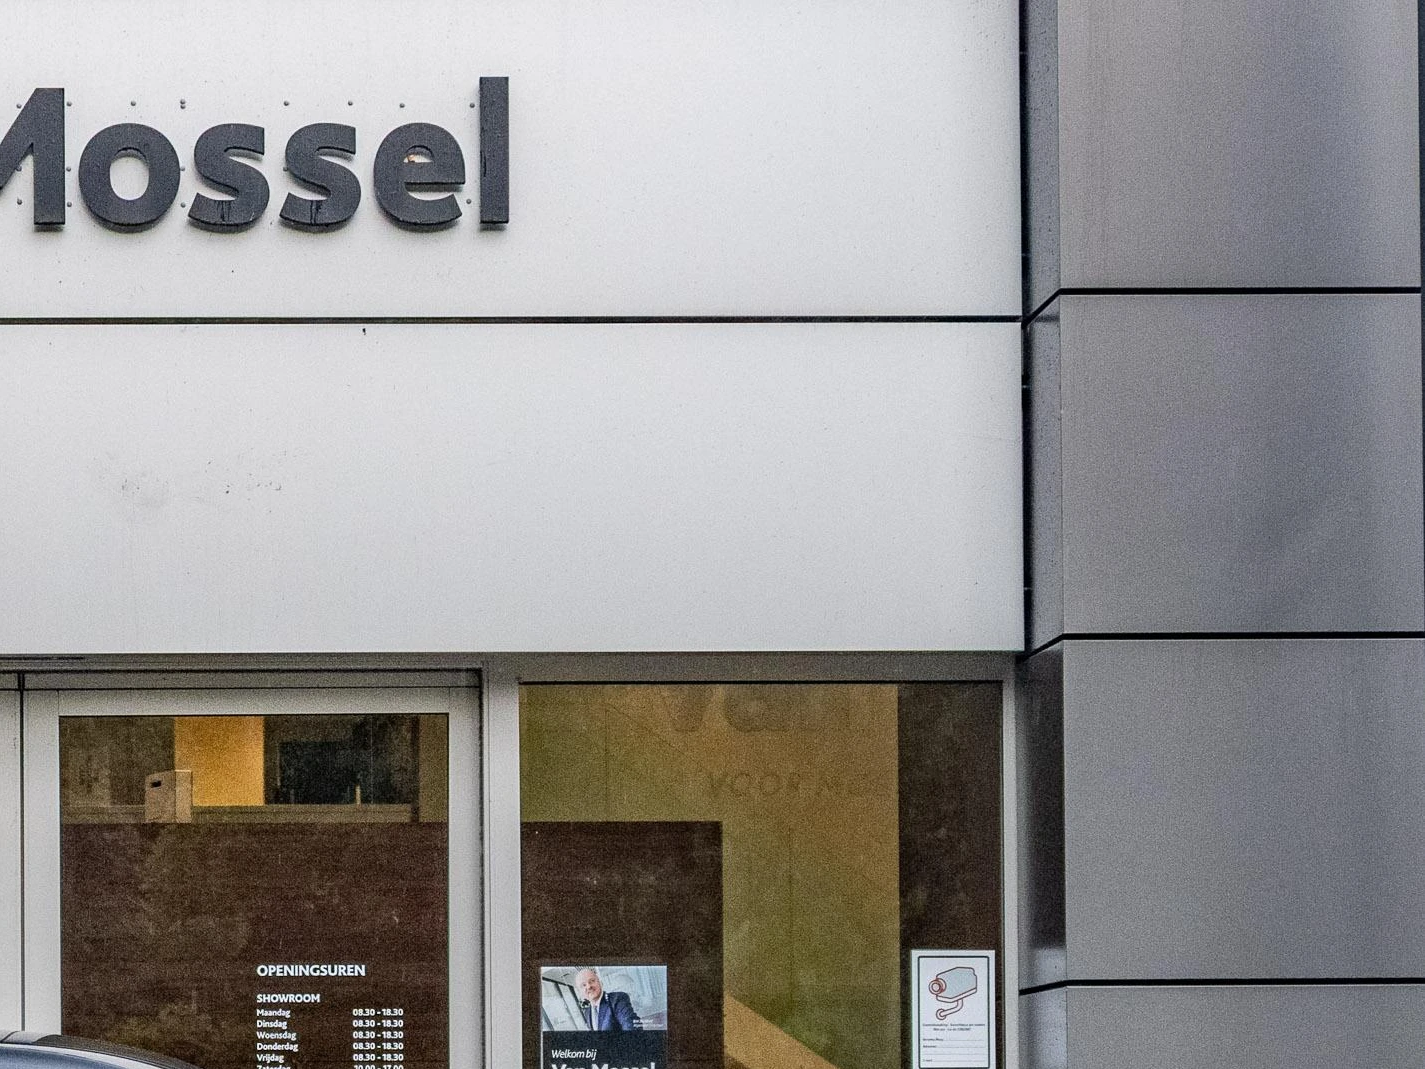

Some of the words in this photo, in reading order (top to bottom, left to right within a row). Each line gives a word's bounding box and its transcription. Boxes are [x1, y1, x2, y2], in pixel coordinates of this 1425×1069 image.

[256, 965, 366, 977] OPENINGSUREN
[256, 994, 321, 1003] SHOWROOM
[256, 1008, 291, 1018] Maandag
[352, 1008, 376, 1017] 08.30
[382, 1008, 404, 1017] 18.30
[256, 1020, 288, 1029] Dinsdag
[352, 1020, 376, 1028] 08.30
[382, 1020, 404, 1028] 18.30
[256, 1031, 297, 1040] Woensdag
[352, 1031, 376, 1039] 08.30
[382, 1031, 404, 1039] 18.30
[256, 1042, 299, 1052] Donderdag
[352, 1042, 376, 1050] 08.30
[382, 1042, 404, 1050] 18.30
[256, 1054, 285, 1063] Vrijdag
[551, 1048, 585, 1059] Welkom
[585, 1048, 598, 1061] bij
